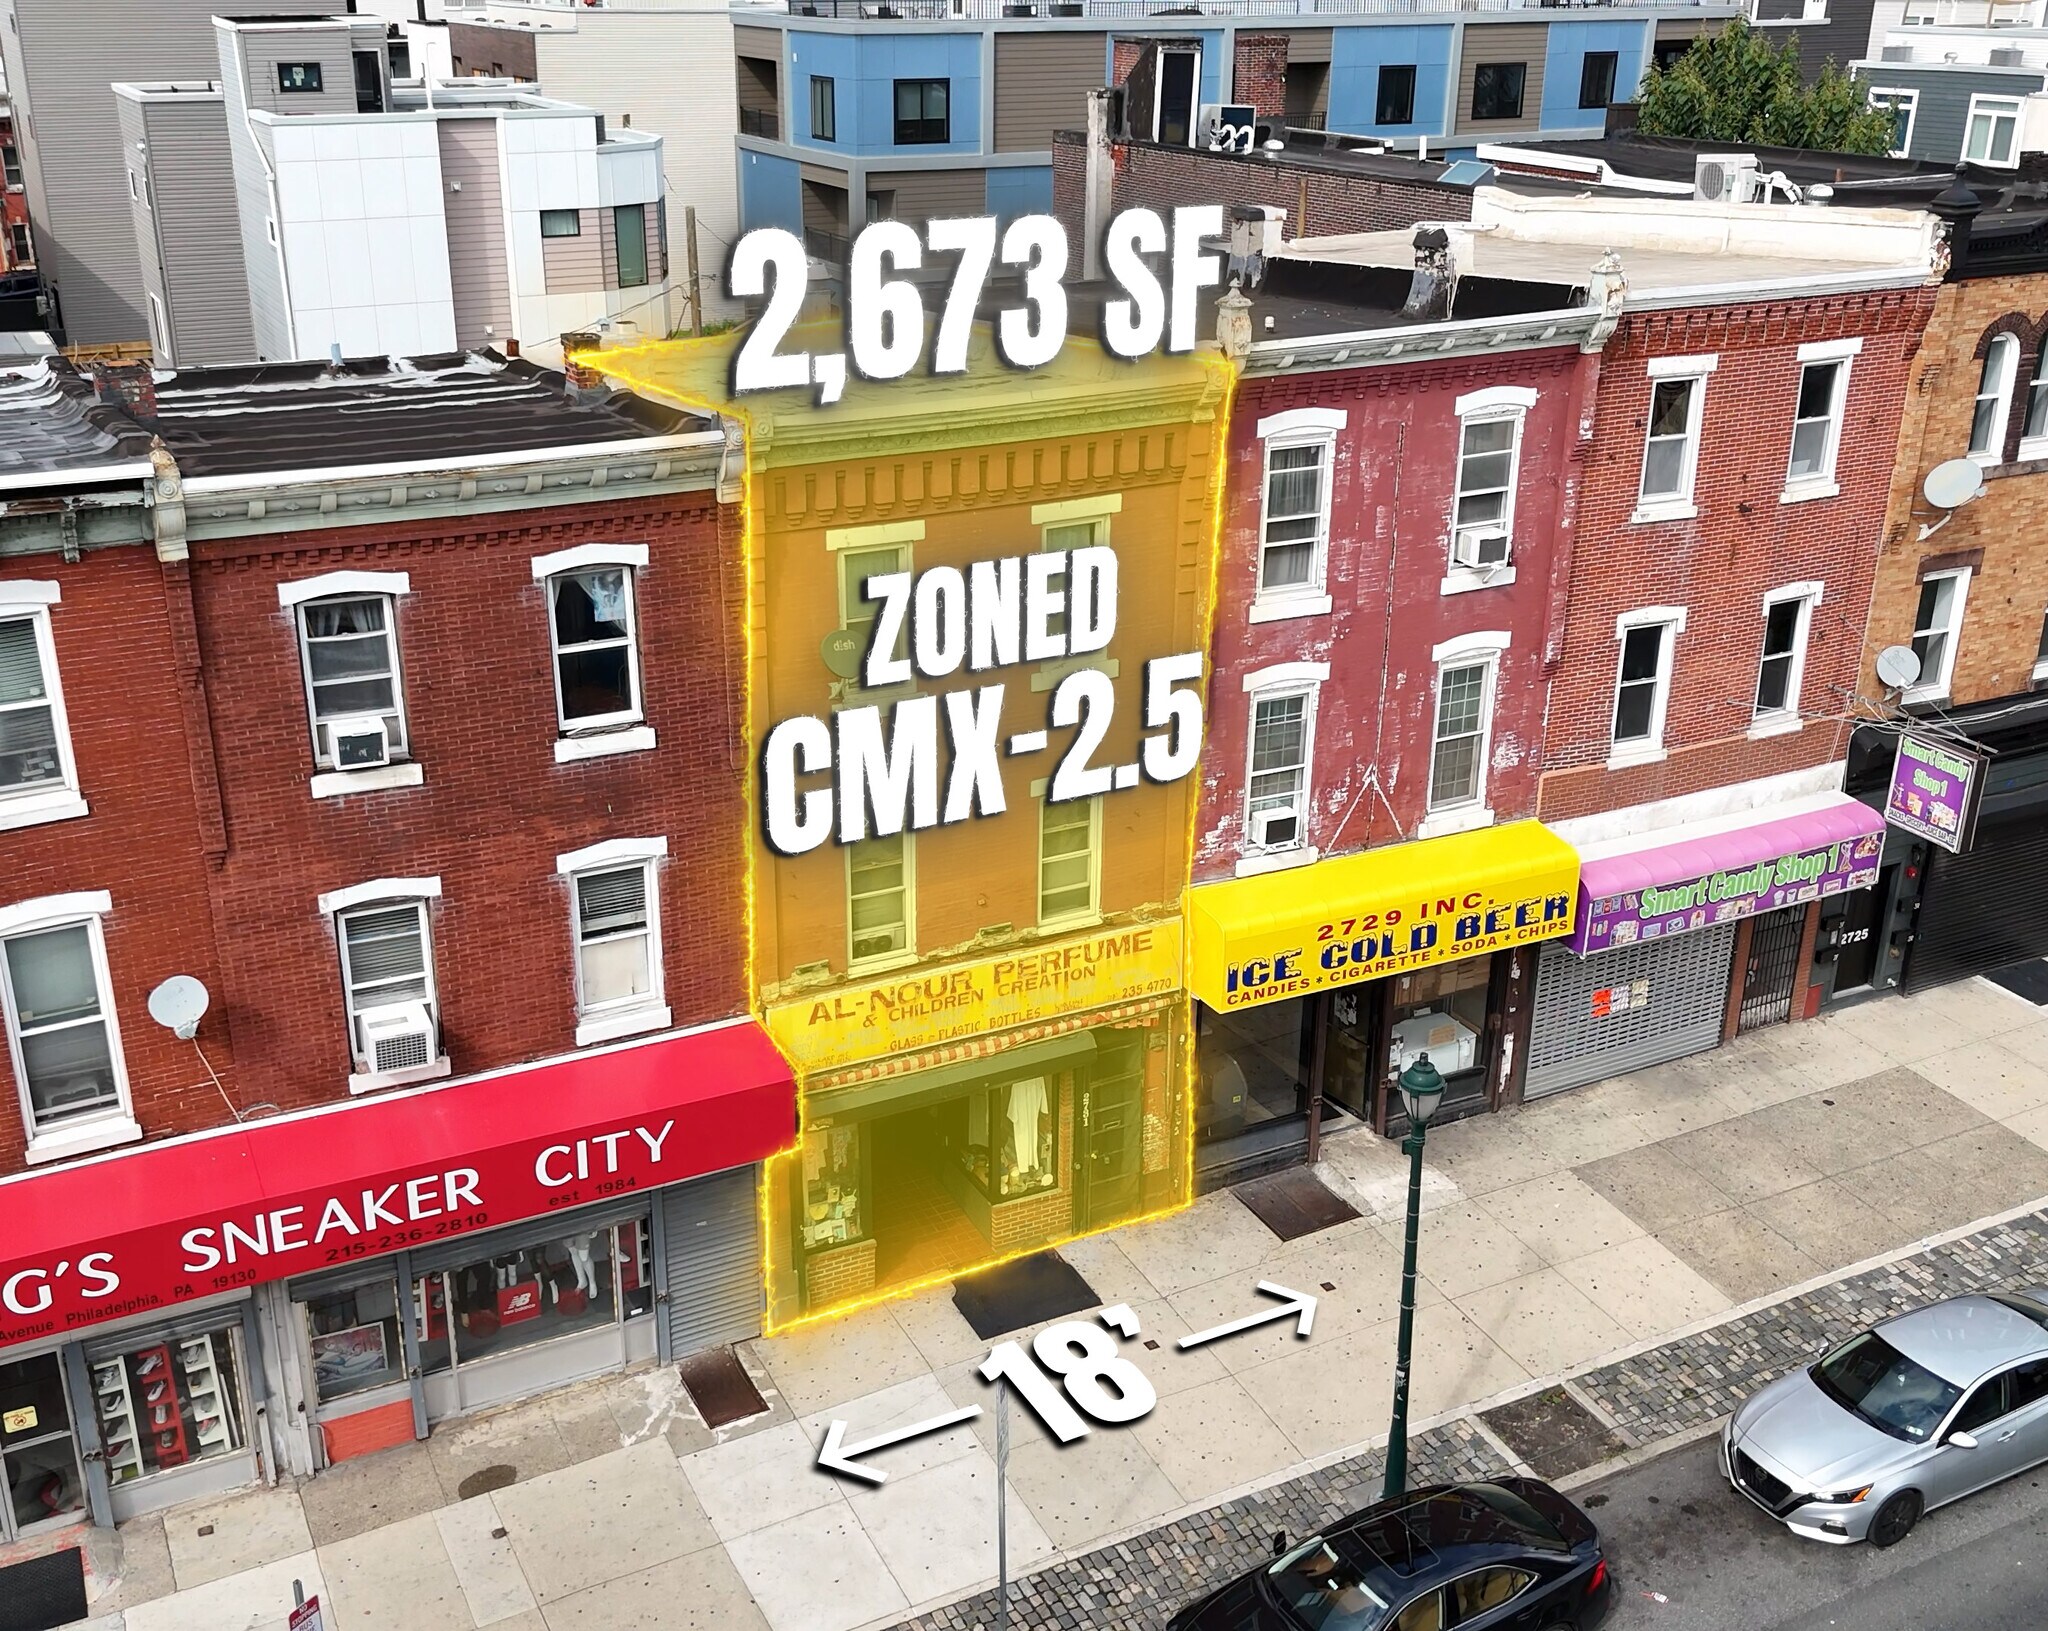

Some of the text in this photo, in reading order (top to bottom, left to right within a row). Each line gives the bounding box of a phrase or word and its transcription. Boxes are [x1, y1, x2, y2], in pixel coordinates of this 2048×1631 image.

[833, 639, 856, 651] dish
[1902, 738, 1969, 783] Smart Candy
[1913, 768, 1940, 797] Shop
[1639, 844, 1839, 919] Smart Candy Shop 1
[1227, 890, 1570, 993] ICE COLD BEER
[1317, 892, 1495, 942] 2729 INC.
[1841, 928, 1869, 945] 2725
[808, 930, 1153, 1026] AL-NOUR PERFUME
[1227, 920, 1568, 1005] CANDIES CIGARETTE SODA CHIPS
[863, 964, 1096, 1028] & CHILDREN CREATION
[890, 1034, 923, 1051] GLASS
[938, 1020, 981, 1042] PLASTIC
[989, 1007, 1041, 1028] BOTTLES
[1122, 984, 1143, 999] 235
[180, 1168, 484, 1273] SNEAKER
[535, 1119, 675, 1187] CITY
[549, 1177, 637, 1206] est 1984
[325, 1212, 488, 1262] 215-236-2810
[66, 1293, 164, 1326] Philadelphia,
[174, 1283, 194, 1299] PA
[212, 1268, 257, 1289] 19130
